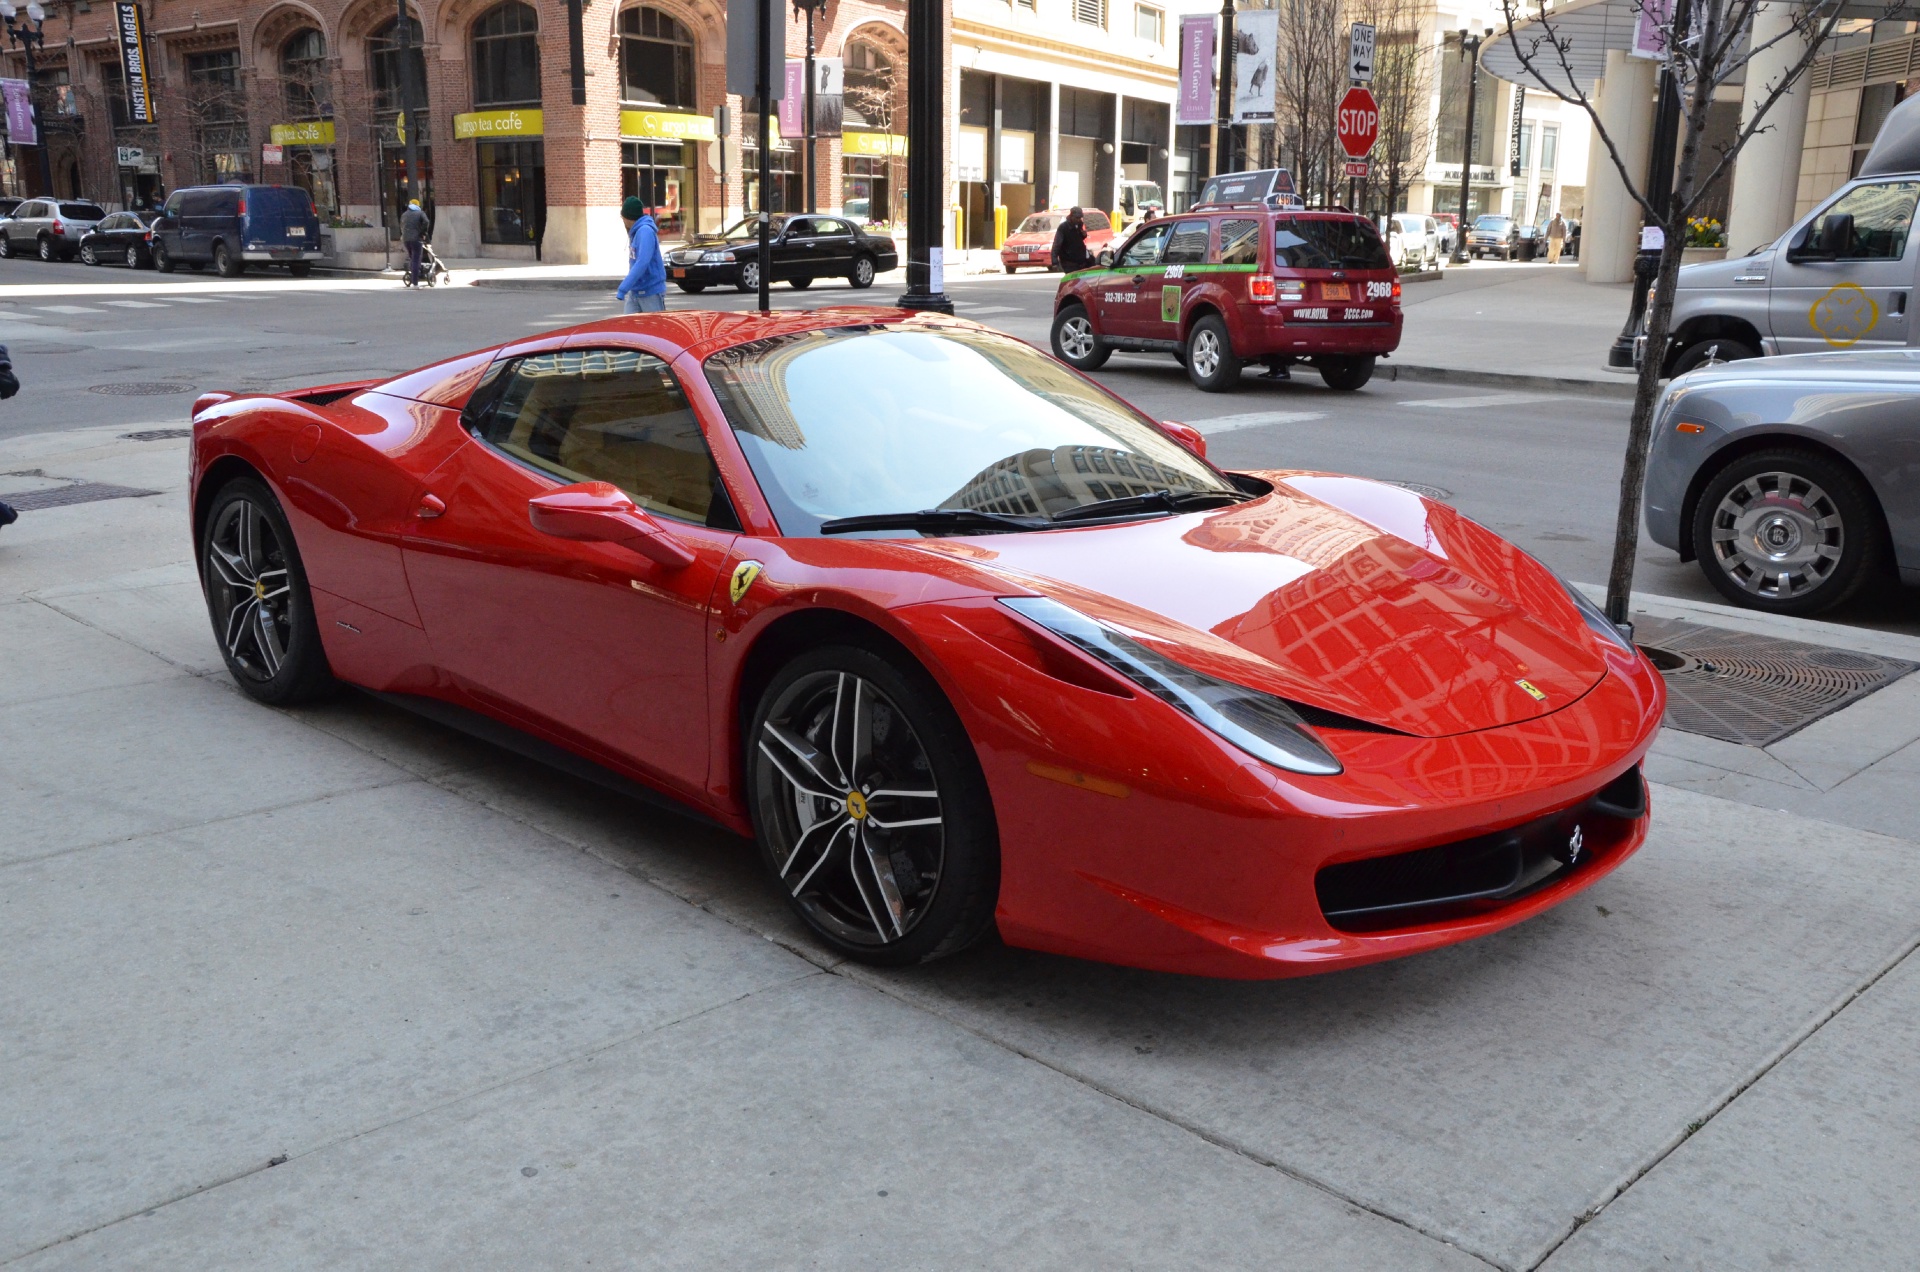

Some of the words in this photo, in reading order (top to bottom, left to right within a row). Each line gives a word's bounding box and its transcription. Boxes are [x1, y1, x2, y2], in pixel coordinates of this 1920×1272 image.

[121, 5, 138, 44] BAGELS
[1354, 28, 1372, 43] ONE
[127, 46, 142, 73] BROS.
[1192, 30, 1203, 68] Edward
[1353, 44, 1372, 59] WAY
[787, 71, 795, 100] Edward
[1189, 69, 1202, 101] Gorey
[130, 76, 147, 120] EINSTEIN
[1511, 84, 1523, 135] ORDSTROM
[479, 118, 493, 131] tea
[495, 111, 522, 130] café
[786, 100, 795, 123] Gorey
[1340, 108, 1377, 136] STOP
[297, 124, 320, 140] café
[661, 121, 686, 136] argo
[1510, 136, 1520, 163] rack
[1275, 194, 1294, 205] 2968
[1164, 265, 1184, 279] 2968
[1366, 281, 1392, 298] 2968
